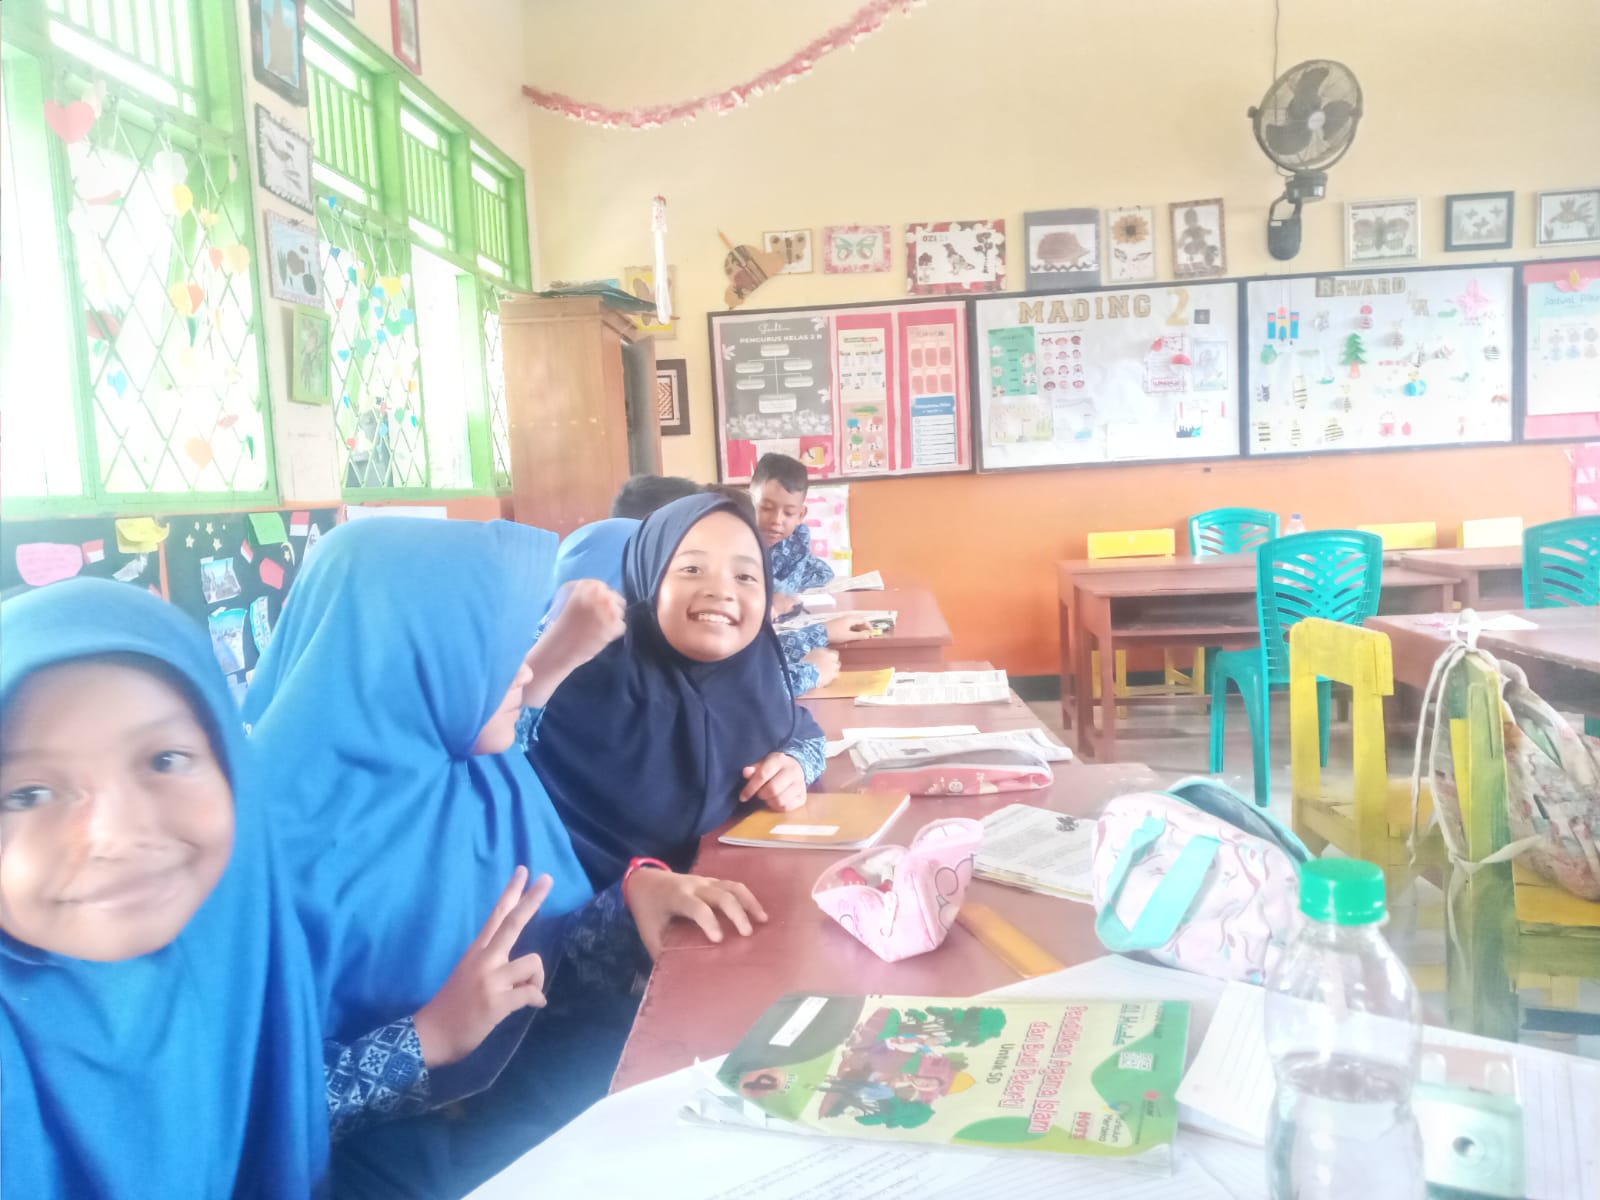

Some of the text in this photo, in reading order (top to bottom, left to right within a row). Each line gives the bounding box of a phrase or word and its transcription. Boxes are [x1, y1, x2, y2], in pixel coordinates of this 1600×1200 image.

[1018, 288, 1189, 326] MADING 2
[1316, 277, 1406, 297] REWARD
[986, 1043, 1017, 1085] Untuk SD
[999, 1020, 1052, 1109] dan Budi Pekerti
[1029, 1005, 1089, 1133] Pendidikan Agama Islam
[1073, 1111, 1092, 1141] HOTS
